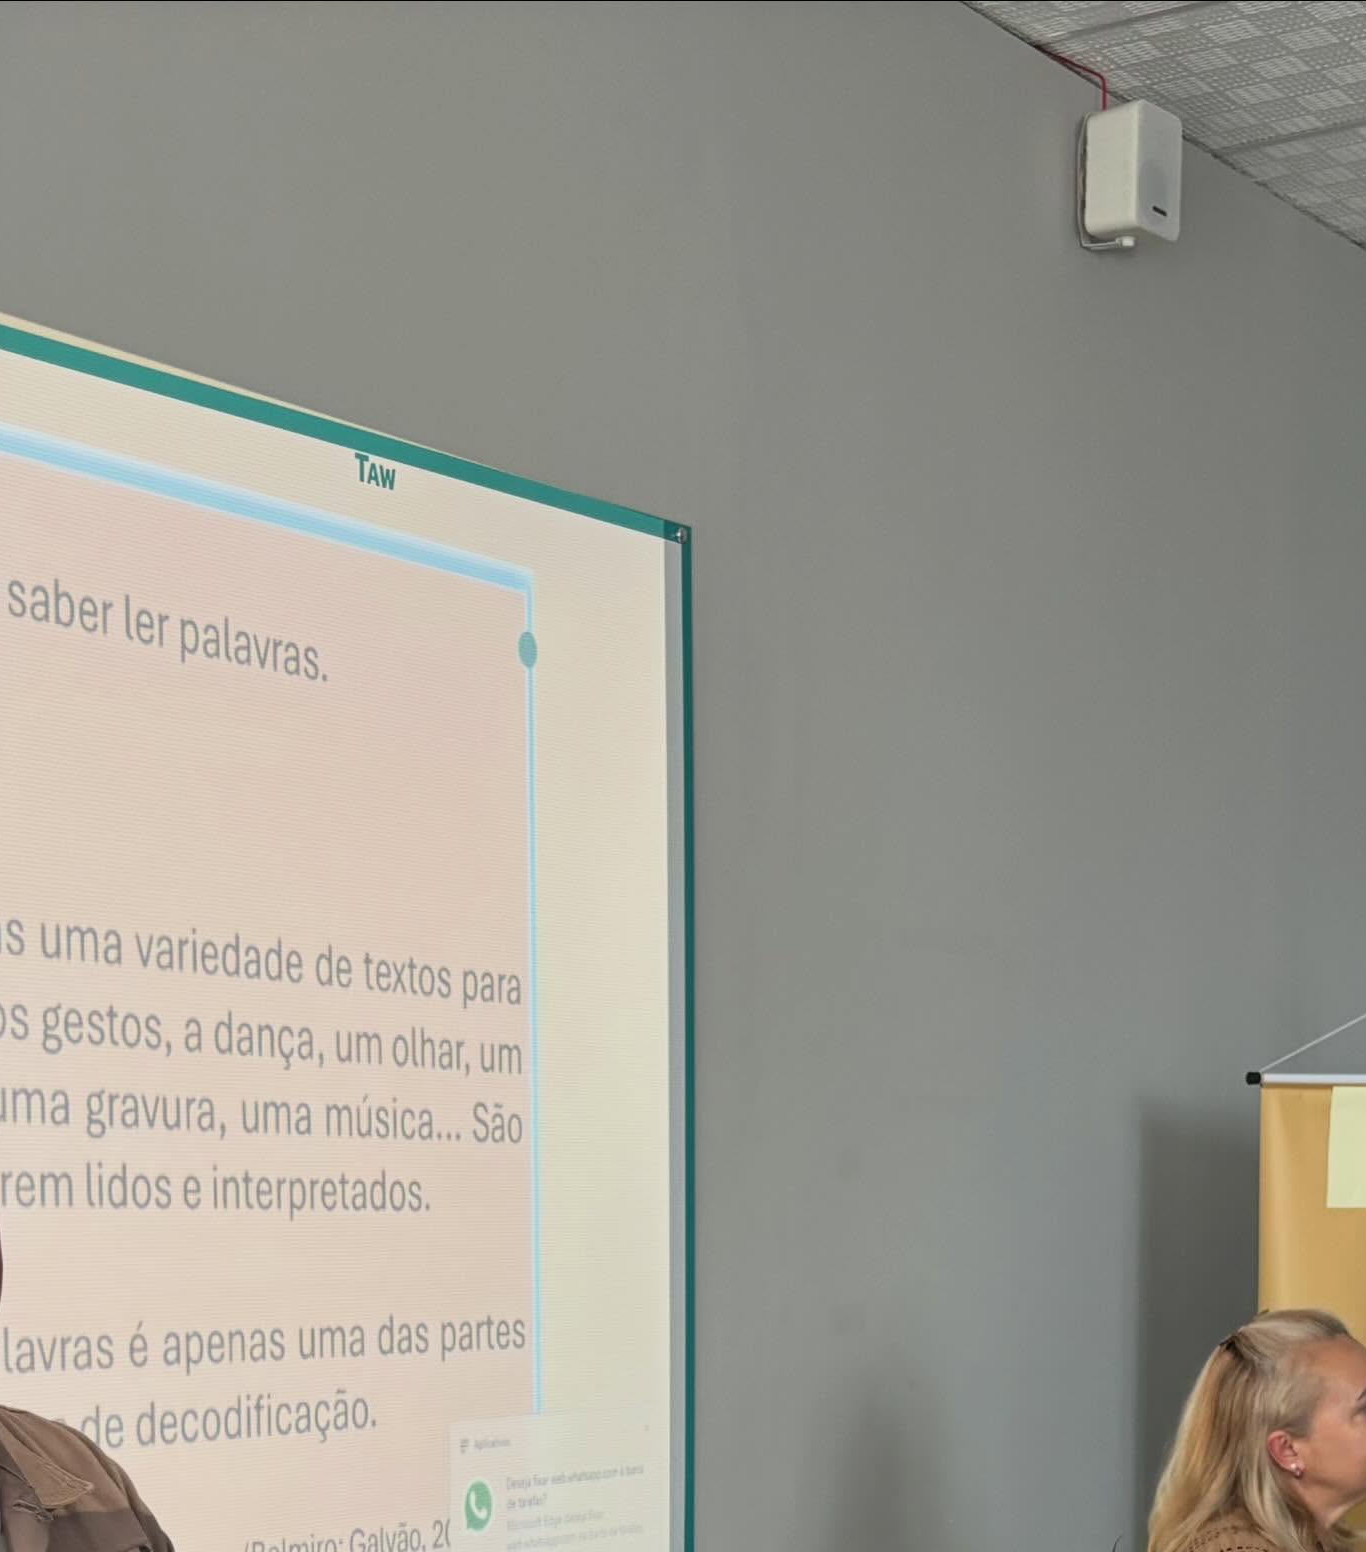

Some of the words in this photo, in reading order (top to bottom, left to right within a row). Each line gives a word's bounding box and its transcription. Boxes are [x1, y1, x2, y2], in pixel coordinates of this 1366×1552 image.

[7, 579, 112, 635] saber
[124, 594, 170, 647] ler
[179, 616, 329, 683] palavras.
[40, 914, 123, 967] uma
[135, 926, 304, 986] variedade
[315, 946, 353, 989] de
[364, 949, 451, 1000] textos
[461, 965, 522, 1010] para
[40, 1003, 173, 1057] gestos,
[184, 1016, 204, 1054] a
[214, 1010, 325, 1070] dança,
[335, 1029, 384, 1067] um
[391, 1023, 471, 1076] olhar,
[479, 1038, 523, 1075] um
[85, 1085, 228, 1139] gravura,
[241, 1097, 313, 1138] uma
[325, 1091, 462, 1143] música...
[471, 1102, 523, 1145] São
[85, 1162, 172, 1211] lidos
[181, 1174, 202, 1212] e
[212, 1165, 432, 1221] interpretados.
[127, 1320, 149, 1371] é
[161, 1324, 286, 1376] apenas
[298, 1321, 366, 1360] uma
[378, 1315, 430, 1358] das
[439, 1312, 527, 1364] partes
[84, 1404, 126, 1451] de
[135, 1388, 378, 1452] decodificação.
